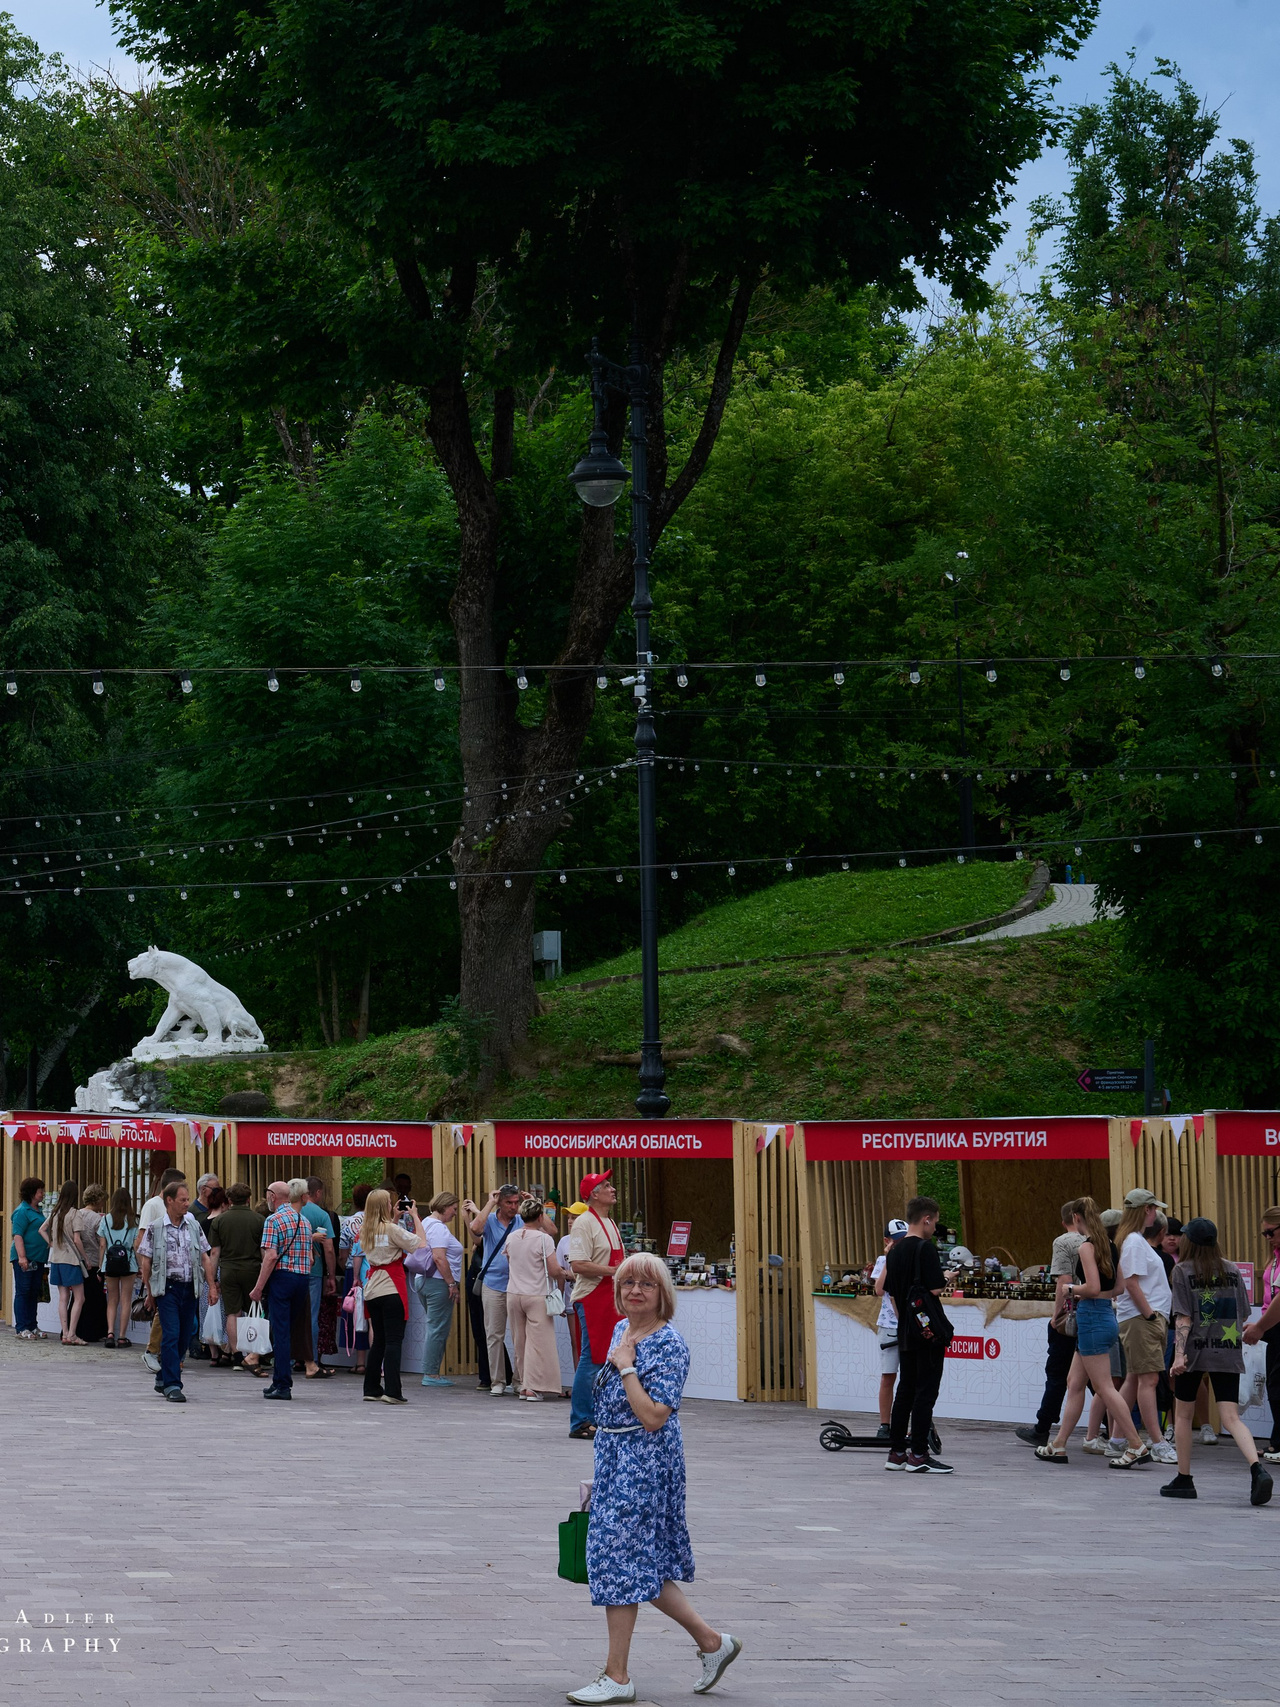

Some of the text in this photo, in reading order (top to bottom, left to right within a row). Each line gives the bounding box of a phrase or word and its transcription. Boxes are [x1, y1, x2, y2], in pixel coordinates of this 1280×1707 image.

[267, 1132, 397, 1148] КЕМЕРОВСКАЯ ОБЛАСТЬ
[524, 1135, 703, 1149] НОВОСИБИРСКАЯ ОБЛАСТЬ
[862, 1131, 1048, 1149] РЕСПУБЛИКА БУРЯТИЯ
